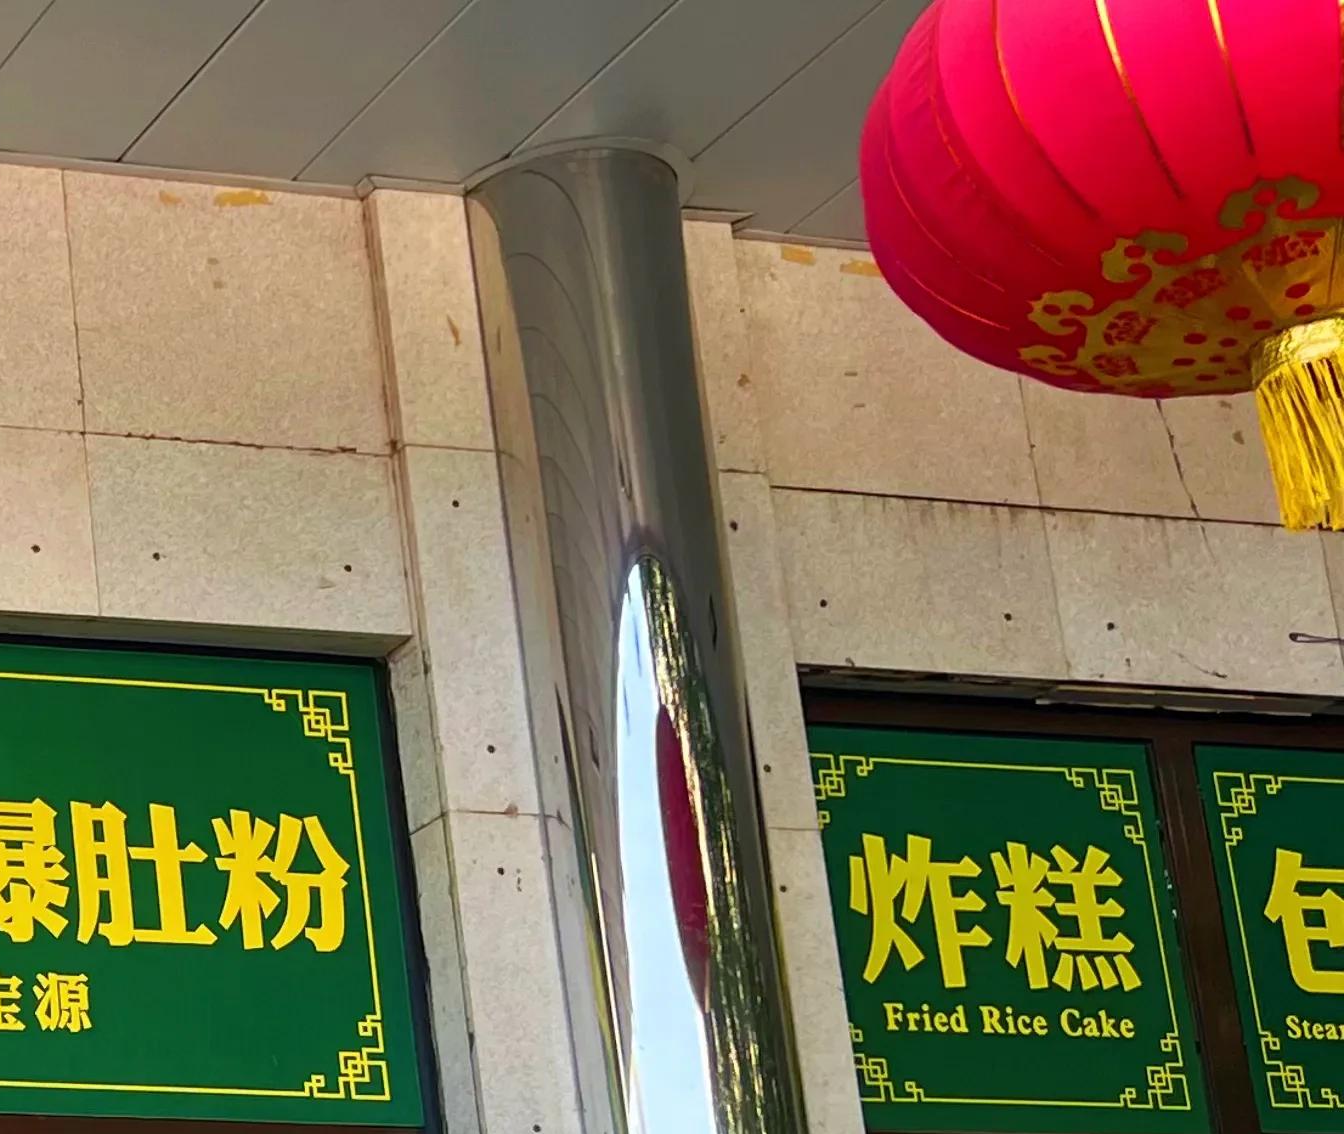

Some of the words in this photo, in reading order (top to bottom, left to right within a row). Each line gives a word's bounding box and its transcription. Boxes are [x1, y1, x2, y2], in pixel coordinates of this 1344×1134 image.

[849, 833, 1142, 992] 炸糕
[883, 1002, 969, 1034] Fried
[980, 1005, 1048, 1036] Rice
[1060, 1009, 1135, 1039] Cake
